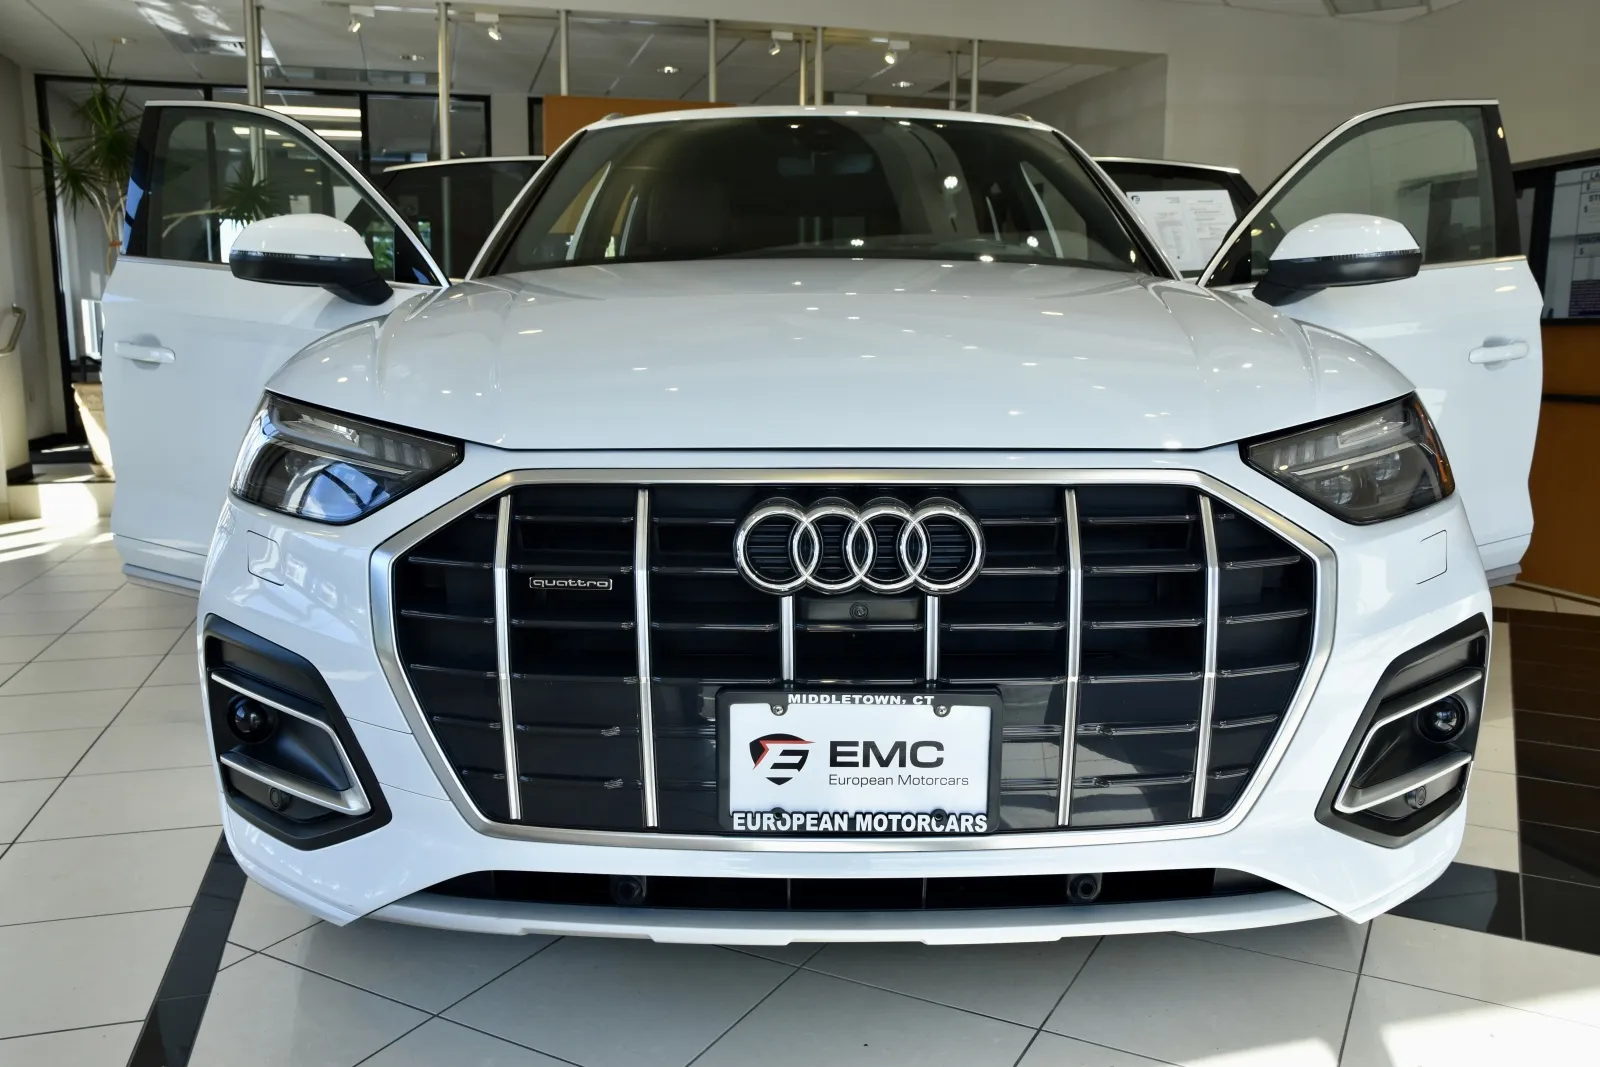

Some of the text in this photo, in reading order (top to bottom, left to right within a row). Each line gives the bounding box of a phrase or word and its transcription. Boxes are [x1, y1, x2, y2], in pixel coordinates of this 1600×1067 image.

[532, 579, 609, 588] quattro
[787, 693, 935, 705] MIDDLETOWN, CT
[829, 740, 945, 769] EMC
[828, 774, 969, 788] European Motorcars
[732, 812, 988, 833] EUROPEAN MOTORCARS
